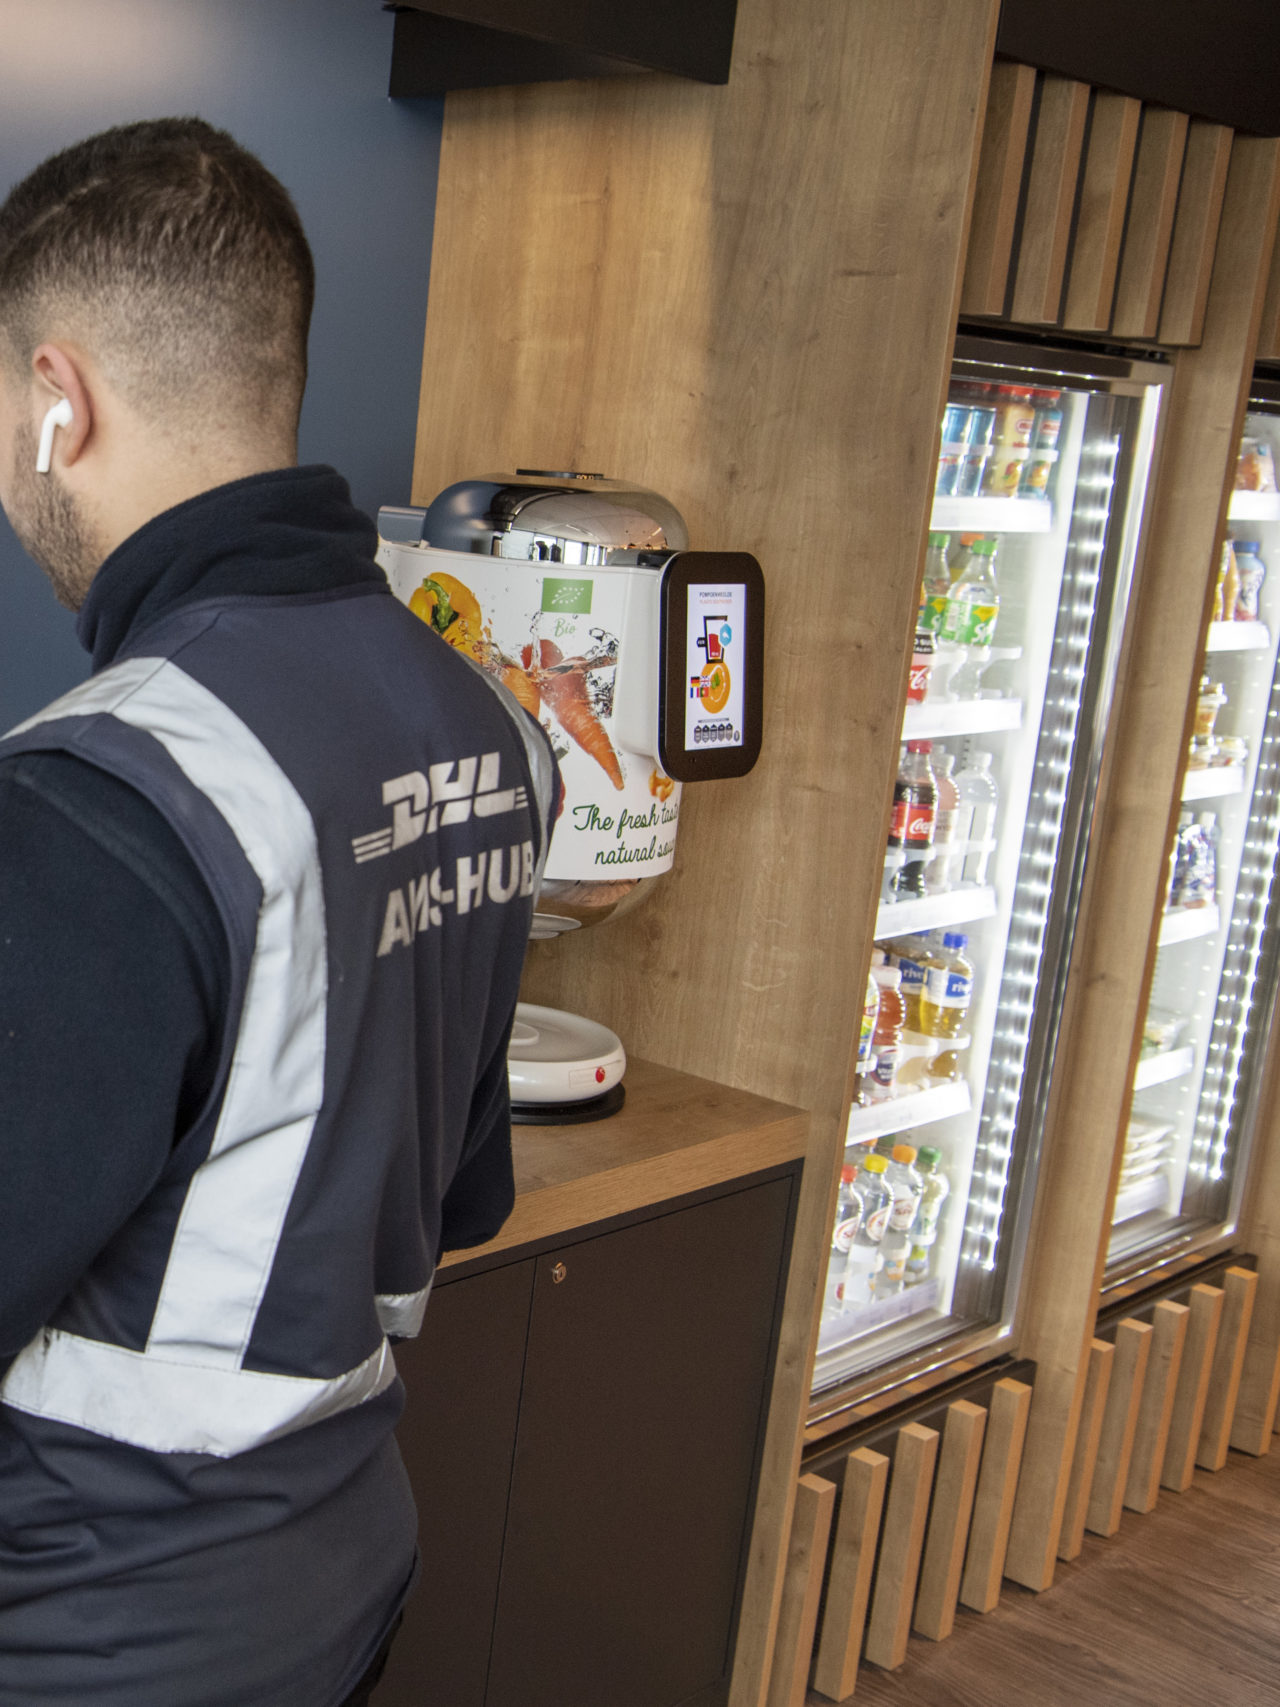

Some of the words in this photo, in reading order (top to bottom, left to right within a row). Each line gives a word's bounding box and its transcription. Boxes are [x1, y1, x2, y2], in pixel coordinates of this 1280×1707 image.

[554, 617, 576, 638] Bio
[382, 752, 516, 850] DHL
[572, 803, 614, 831] The
[616, 802, 659, 839] fresh
[595, 835, 657, 864] natural
